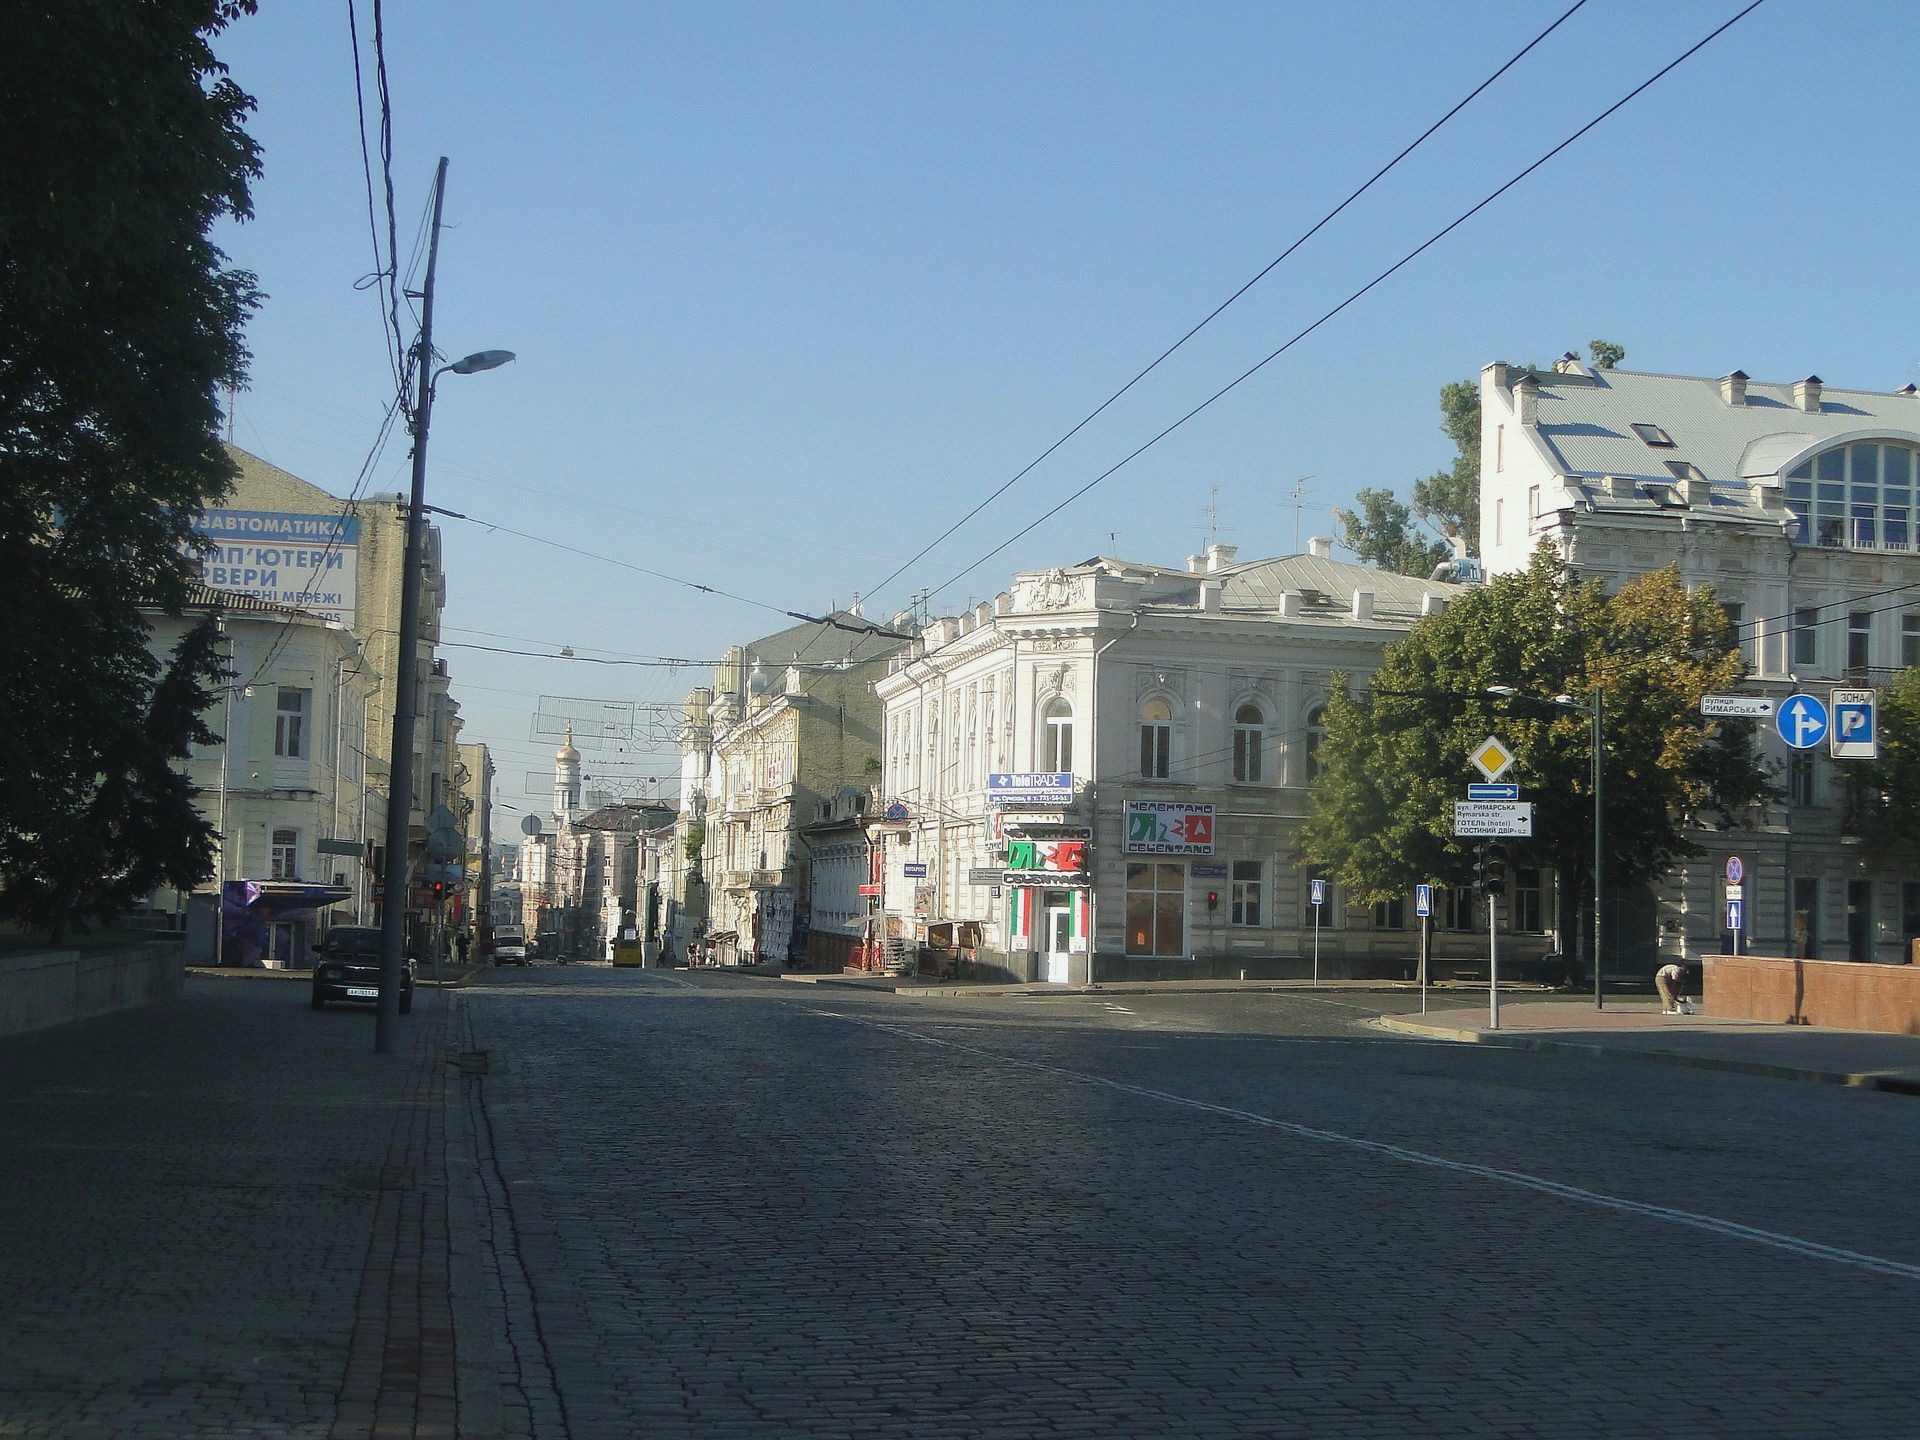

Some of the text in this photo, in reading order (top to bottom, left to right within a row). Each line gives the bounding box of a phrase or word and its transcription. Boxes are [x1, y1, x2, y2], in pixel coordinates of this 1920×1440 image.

[282, 591, 342, 604] МЕРЕЖІ
[1840, 693, 1866, 703] ЗОНА
[1705, 705, 1757, 713] РИМАРСЬКА
[1129, 802, 1213, 813] ЧЕЛЕНТАНО
[1129, 843, 1212, 854] CELENTANO
